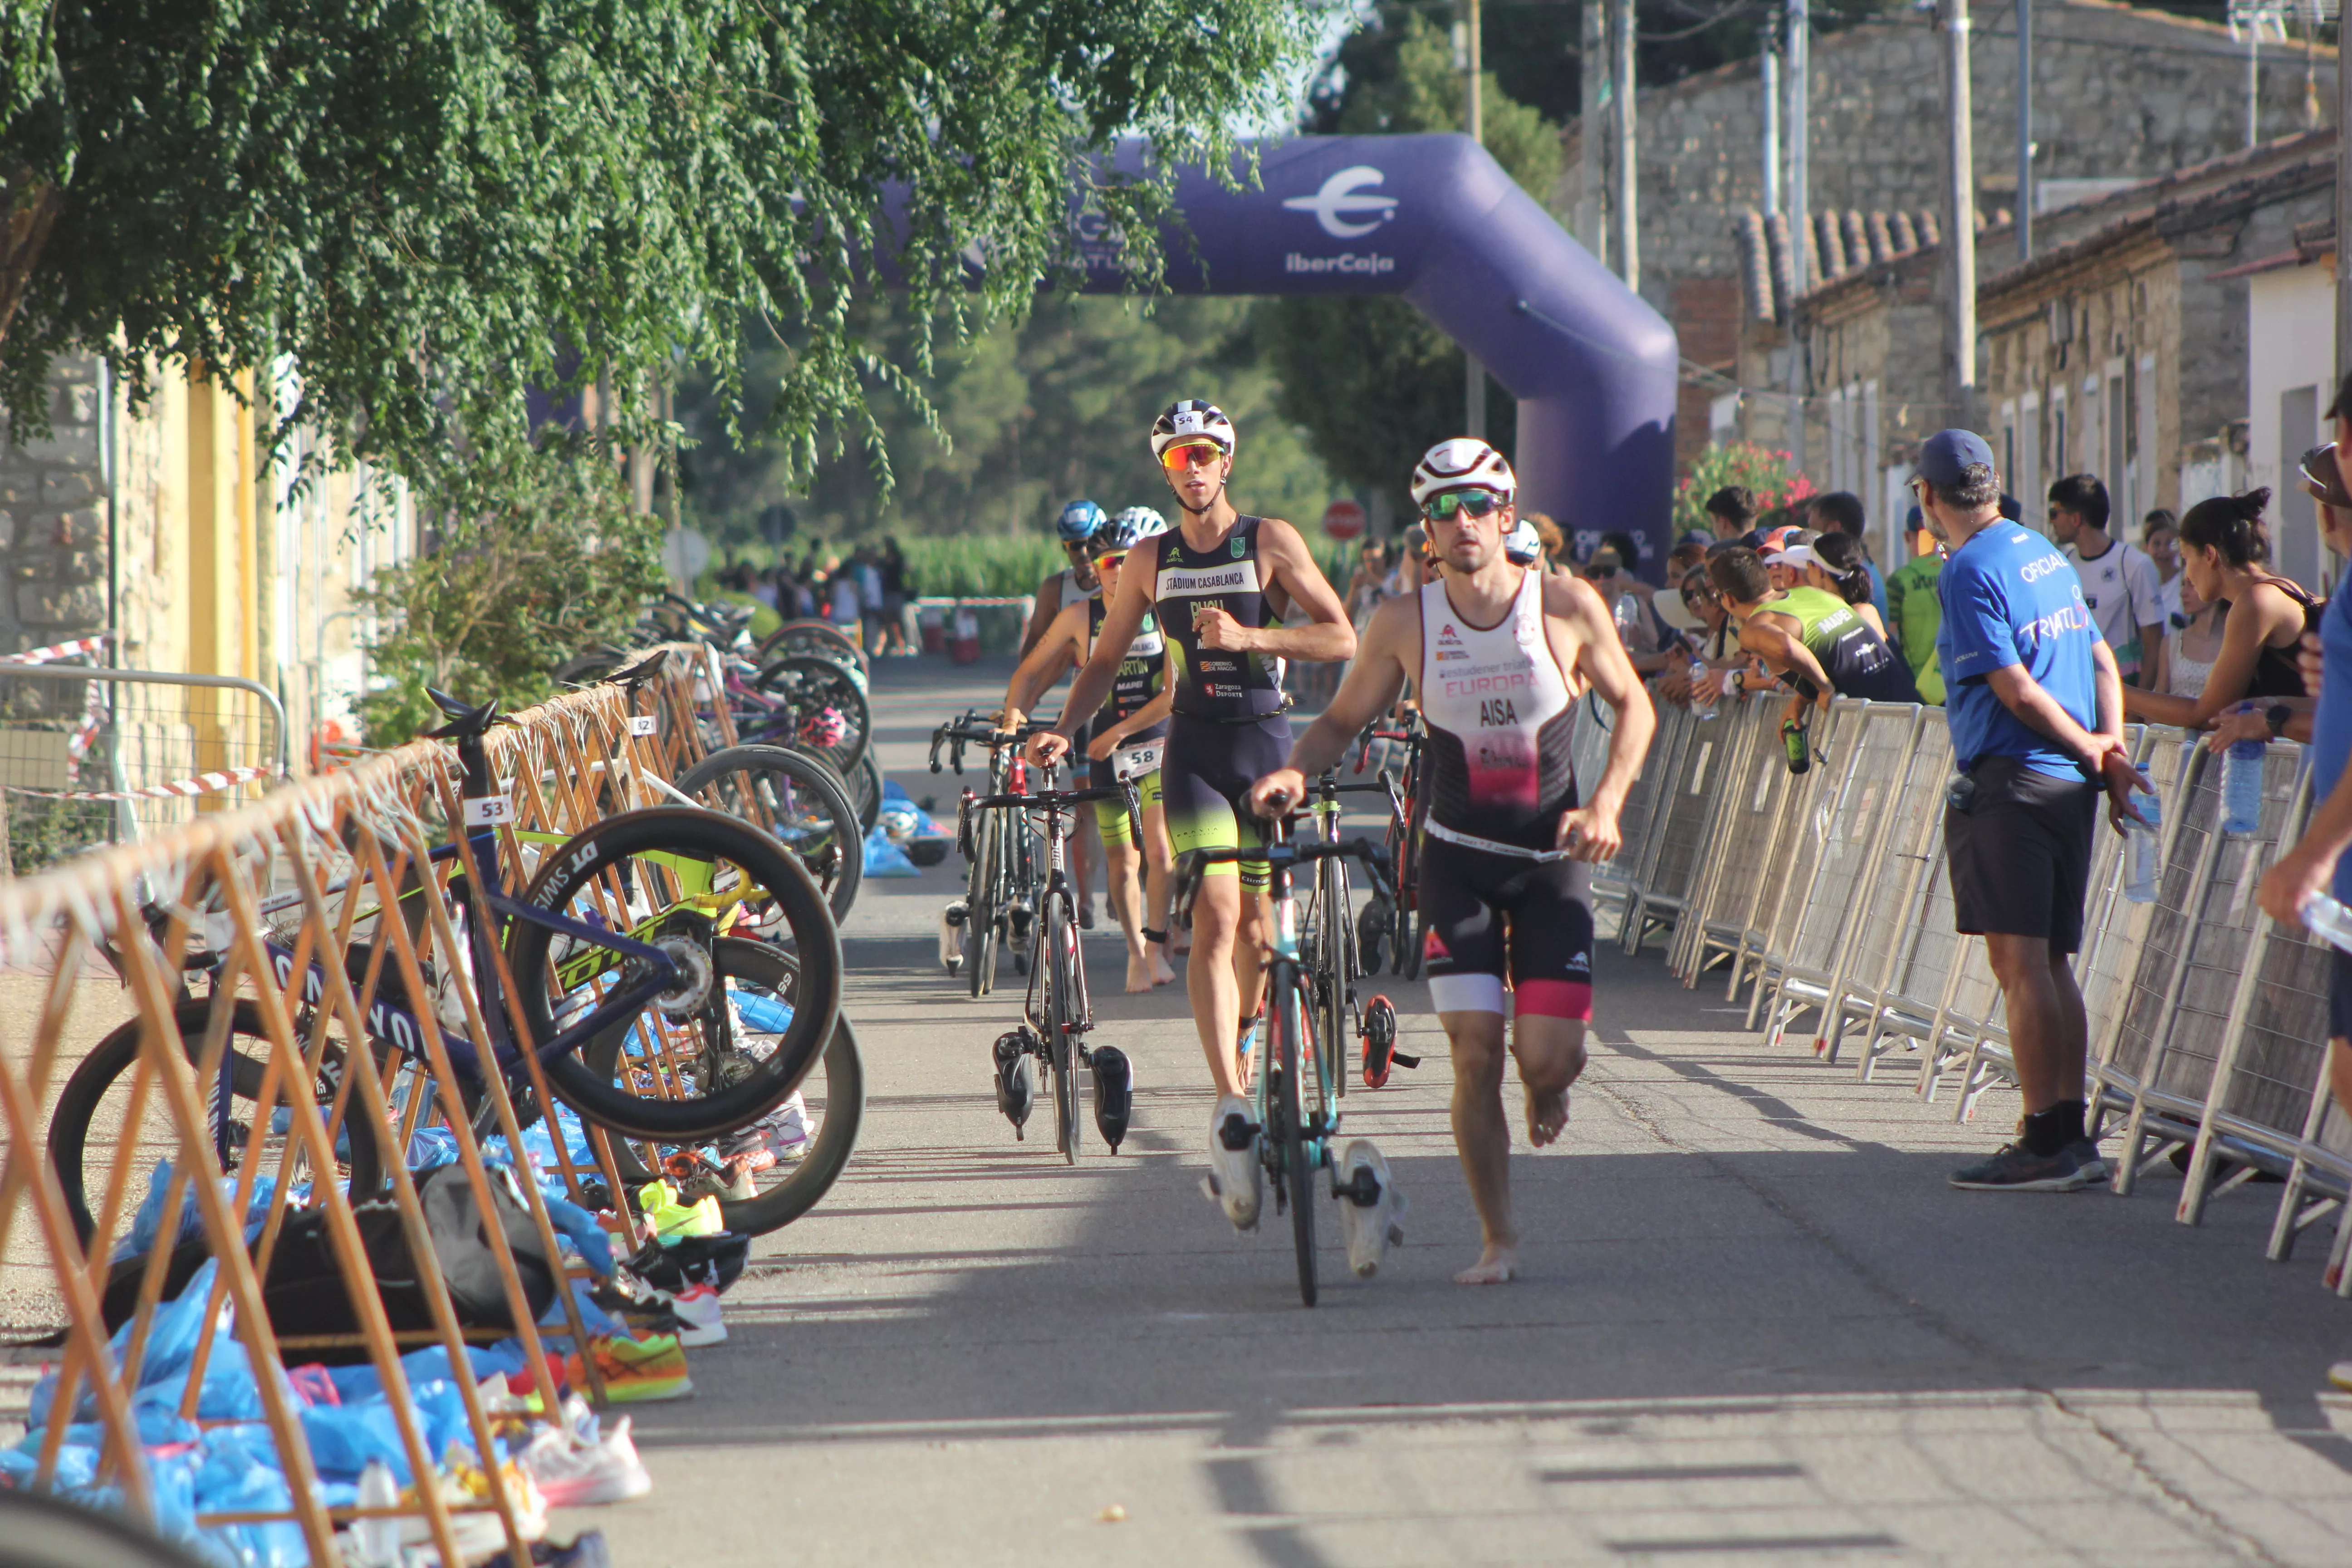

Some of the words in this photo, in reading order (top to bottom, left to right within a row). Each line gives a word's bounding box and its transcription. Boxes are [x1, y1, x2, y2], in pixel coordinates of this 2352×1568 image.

[1179, 415, 1194, 425] 54
[2021, 552, 2069, 583] OFICIAL
[1166, 578, 1196, 590] STADIUM
[1198, 572, 1244, 588] CASABLANCA
[1130, 641, 1155, 652] ABLANCA
[1117, 657, 1149, 676] ARTÍN
[1446, 666, 1500, 678] estudener
[1117, 680, 1143, 691] MAPEI
[1215, 683, 1241, 691] Zaragoza
[1446, 673, 1543, 698] EUROPA
[1480, 699, 1518, 726] AISA
[1132, 751, 1154, 764] 58
[482, 802, 504, 818] 53
[1177, 827, 1219, 838] PRAVIA
[571, 840, 599, 874] DT
[1051, 838, 1061, 870] BMC
[777, 972, 793, 995] 65
